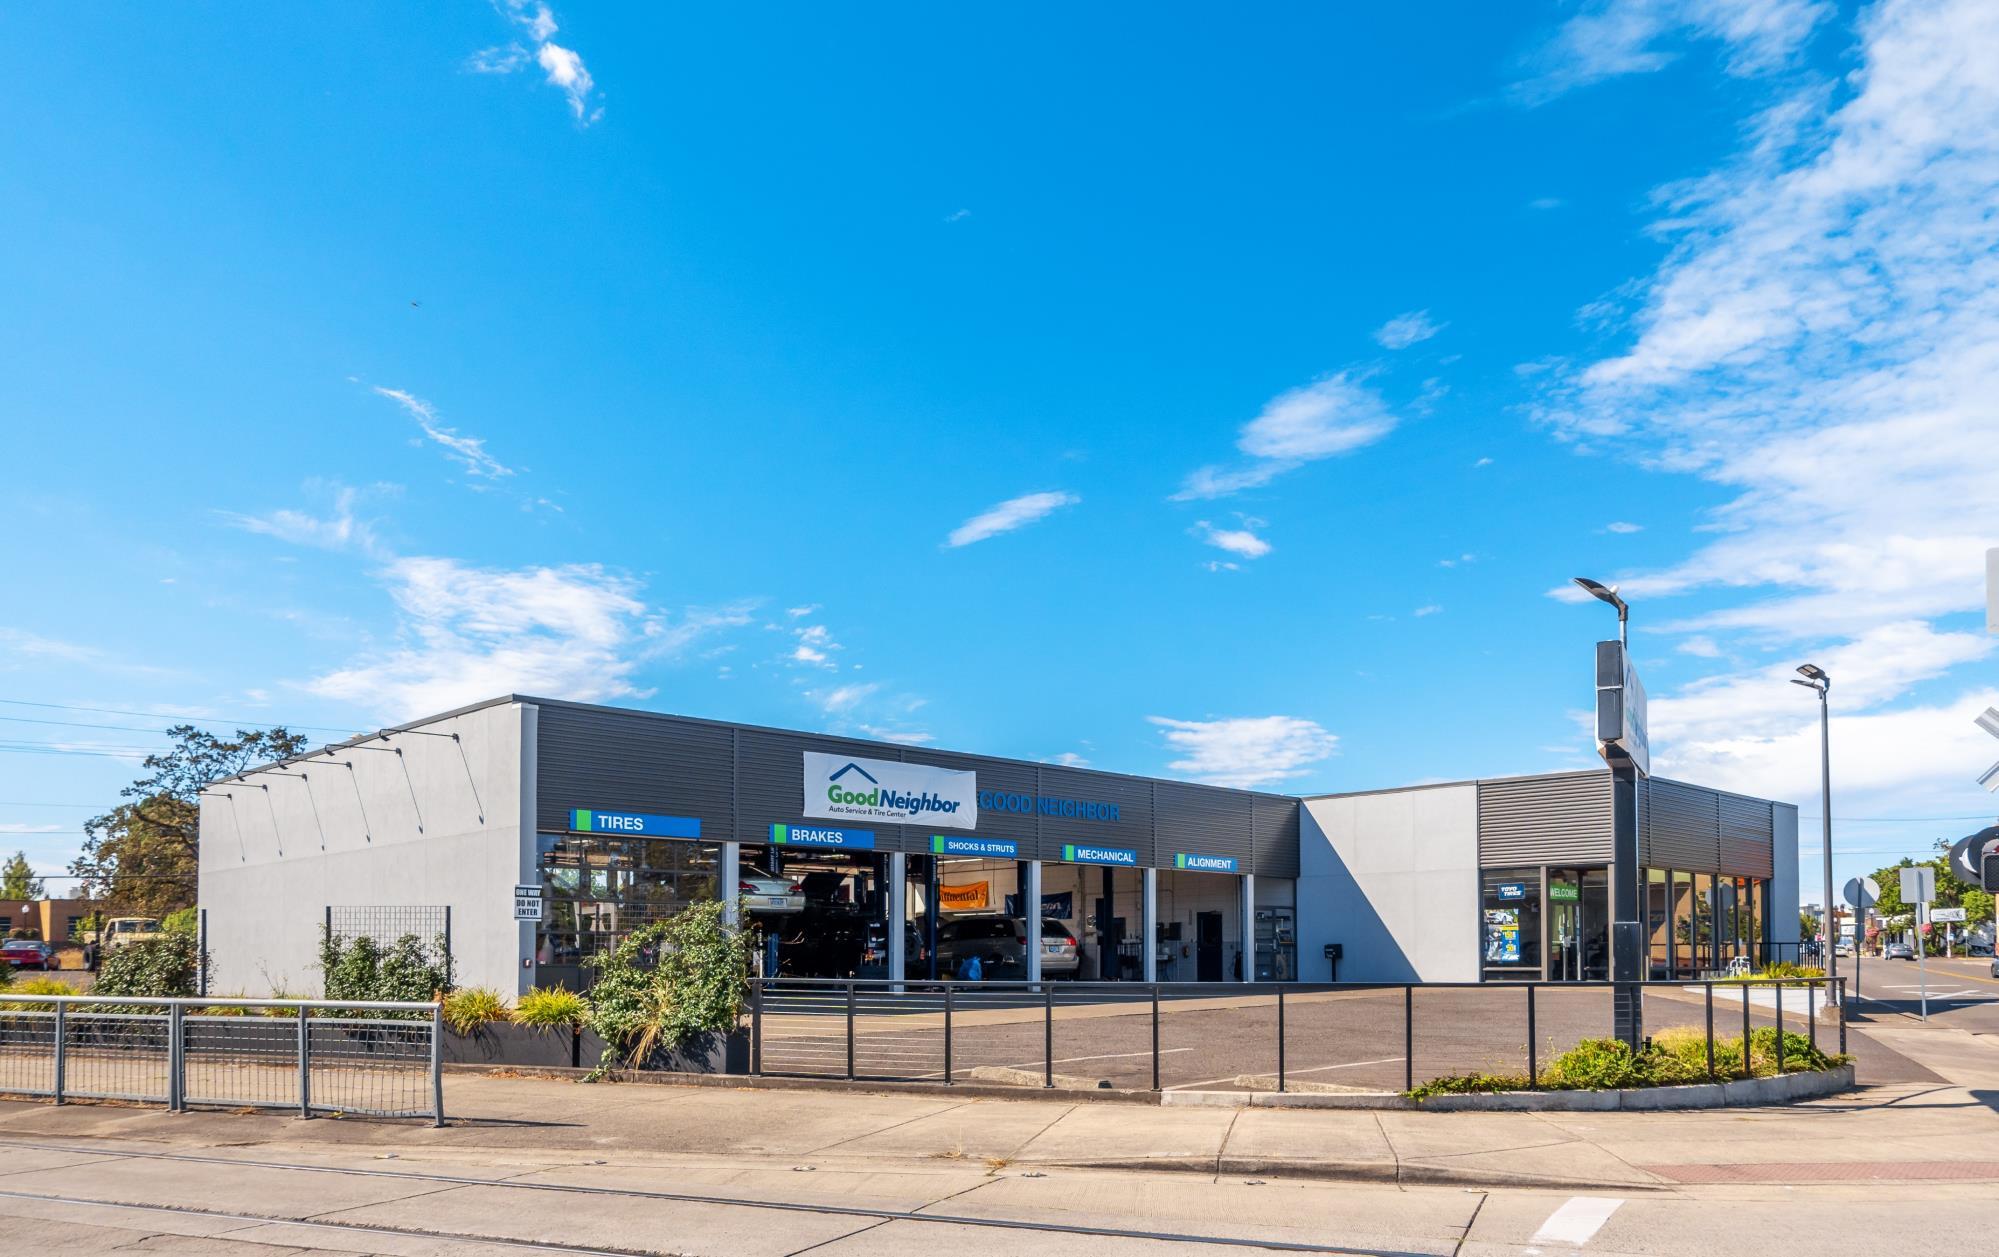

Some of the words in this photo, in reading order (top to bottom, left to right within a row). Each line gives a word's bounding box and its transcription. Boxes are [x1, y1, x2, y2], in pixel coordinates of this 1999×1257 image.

[829, 805, 844, 813] Auto
[845, 806, 867, 815] Service
[873, 808, 886, 816] Tire
[886, 810, 907, 818] Center
[979, 790, 1031, 814] GOOD
[1037, 796, 1120, 821] NEIGHBOR
[598, 815, 644, 831] TIRES
[791, 829, 843, 843] BRAKES
[948, 841, 979, 851] SHOCKS
[987, 845, 1015, 853] STRUTS
[1077, 849, 1134, 863] MECHANICAL
[1187, 857, 1232, 869] ALIGNMENT
[1550, 887, 1578, 898] WELCOME
[527, 900, 540, 908] NOT
[518, 908, 538, 916] ENTER
